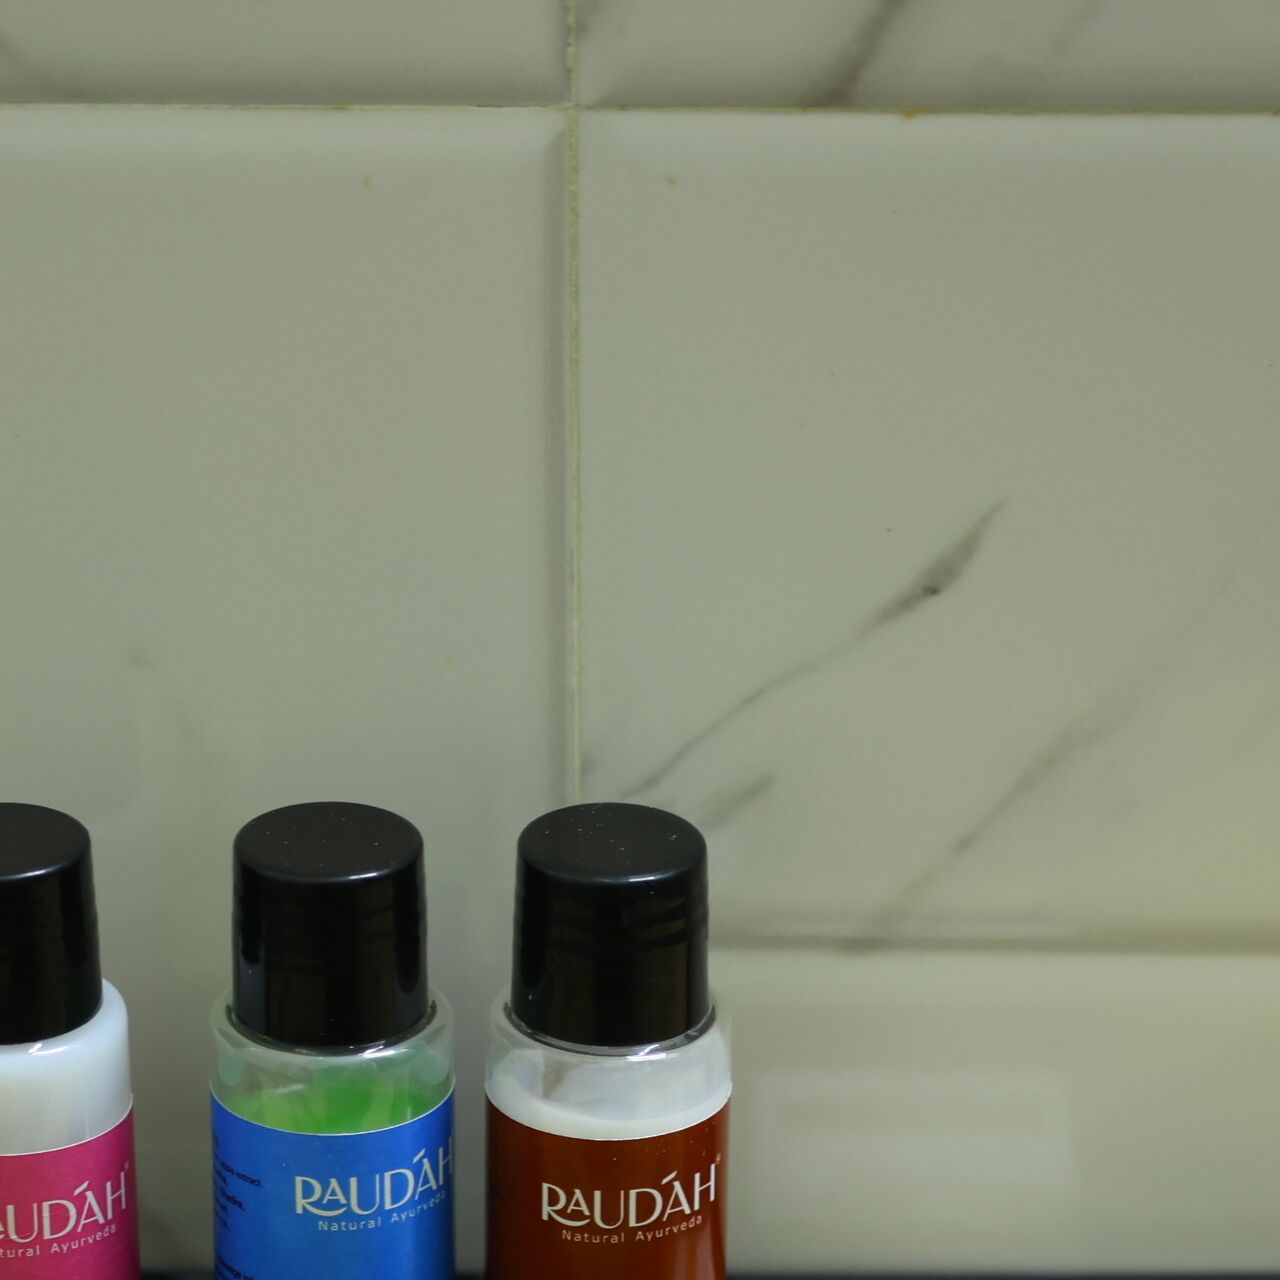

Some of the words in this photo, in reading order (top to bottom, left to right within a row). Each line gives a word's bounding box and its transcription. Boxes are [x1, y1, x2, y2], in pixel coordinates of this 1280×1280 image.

[318, 1217, 382, 1232] Natural
[562, 1229, 625, 1244] Natural
[635, 1215, 703, 1242] Ayurveda
[50, 1225, 116, 1255] Ayurveda
